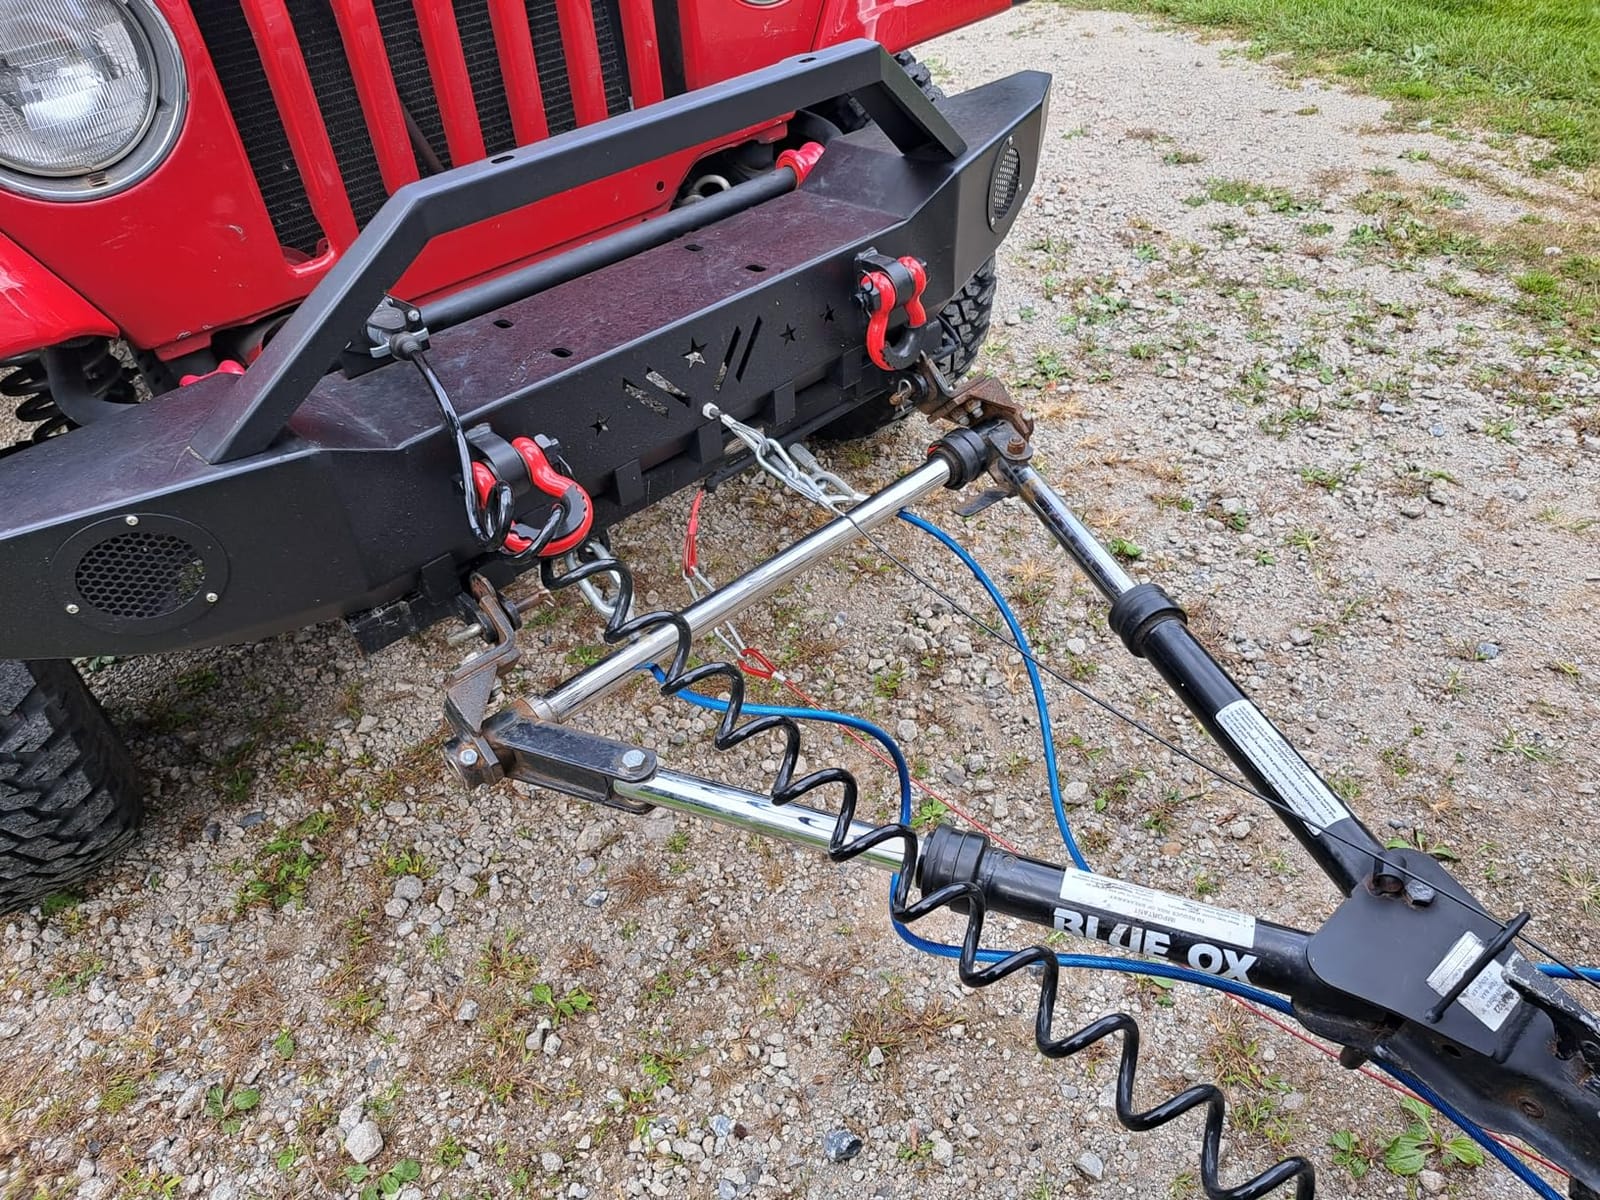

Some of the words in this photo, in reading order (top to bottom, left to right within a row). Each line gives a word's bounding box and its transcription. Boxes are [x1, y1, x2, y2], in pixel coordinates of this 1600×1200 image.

[1277, 739, 1308, 774] IMPORTANT
[1133, 907, 1176, 923] IMPORTANT
[1053, 907, 1171, 961] BLUE
[1187, 942, 1257, 985] OX
